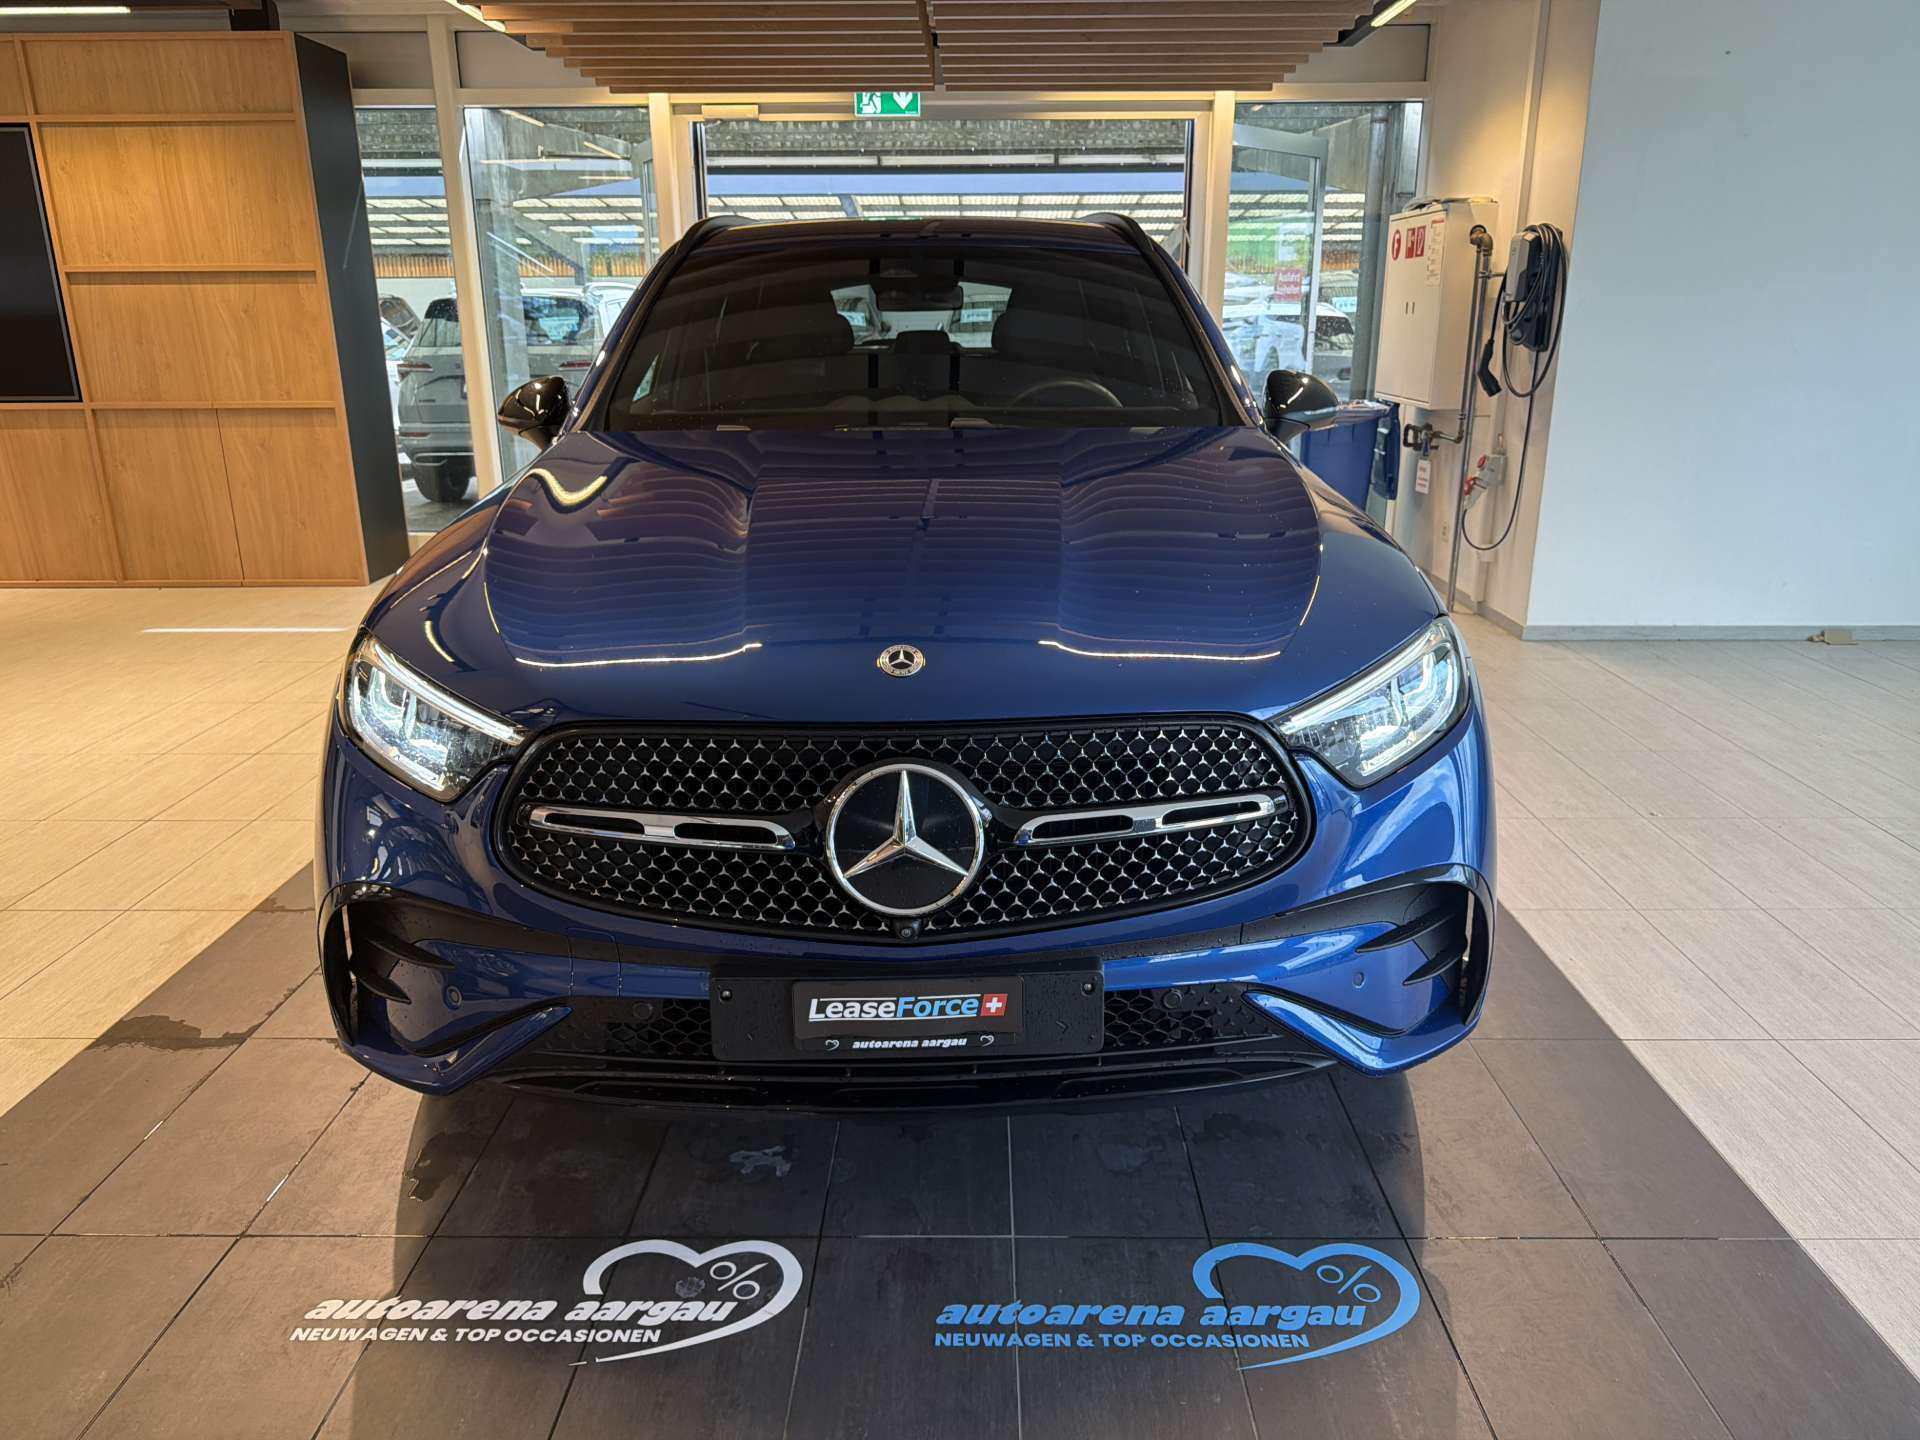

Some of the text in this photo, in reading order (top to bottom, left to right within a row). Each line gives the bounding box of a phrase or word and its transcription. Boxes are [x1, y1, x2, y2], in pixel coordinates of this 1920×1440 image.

[809, 997, 979, 1019] LeaseForce
[852, 1038, 967, 1049] autoarena aargau
[710, 1261, 769, 1300] %
[1316, 1265, 1381, 1303] %
[304, 1295, 738, 1326] autoarena aargau
[936, 1299, 1367, 1331] autoarena aargau
[289, 1327, 661, 1343] NEUWAGEN & TOP OCCASIONEN
[935, 1333, 1309, 1349] NEUWAGEN & TOP OCCASIONEN
